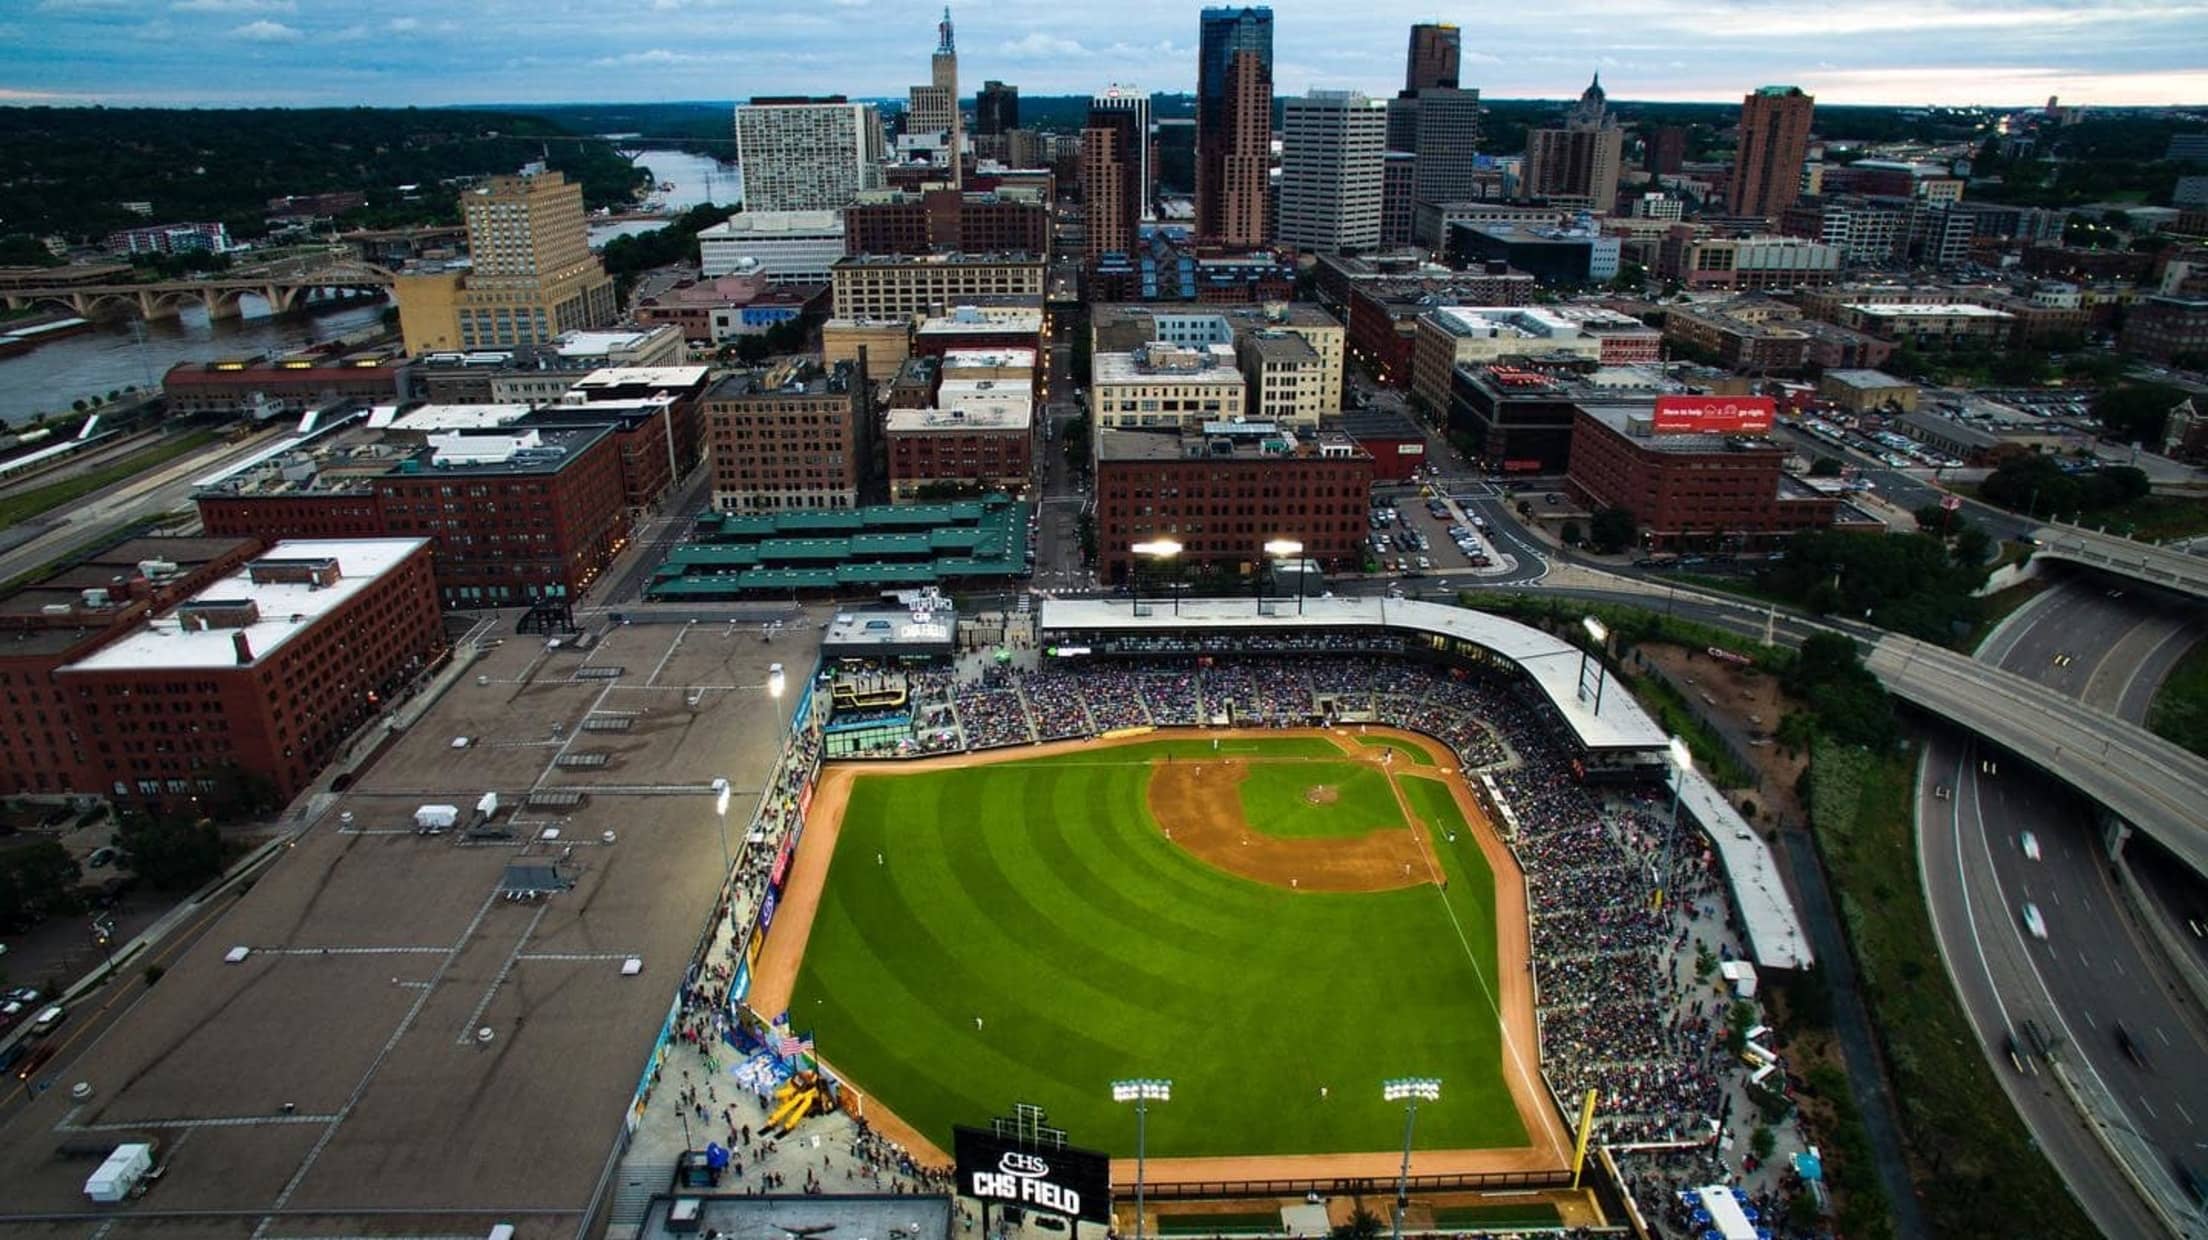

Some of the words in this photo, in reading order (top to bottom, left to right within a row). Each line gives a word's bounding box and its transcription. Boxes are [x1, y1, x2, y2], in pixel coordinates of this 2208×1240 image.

[1003, 1152, 1044, 1172] CHS
[973, 1172, 1017, 1199] CHS
[1021, 1178, 1081, 1216] FIELD
